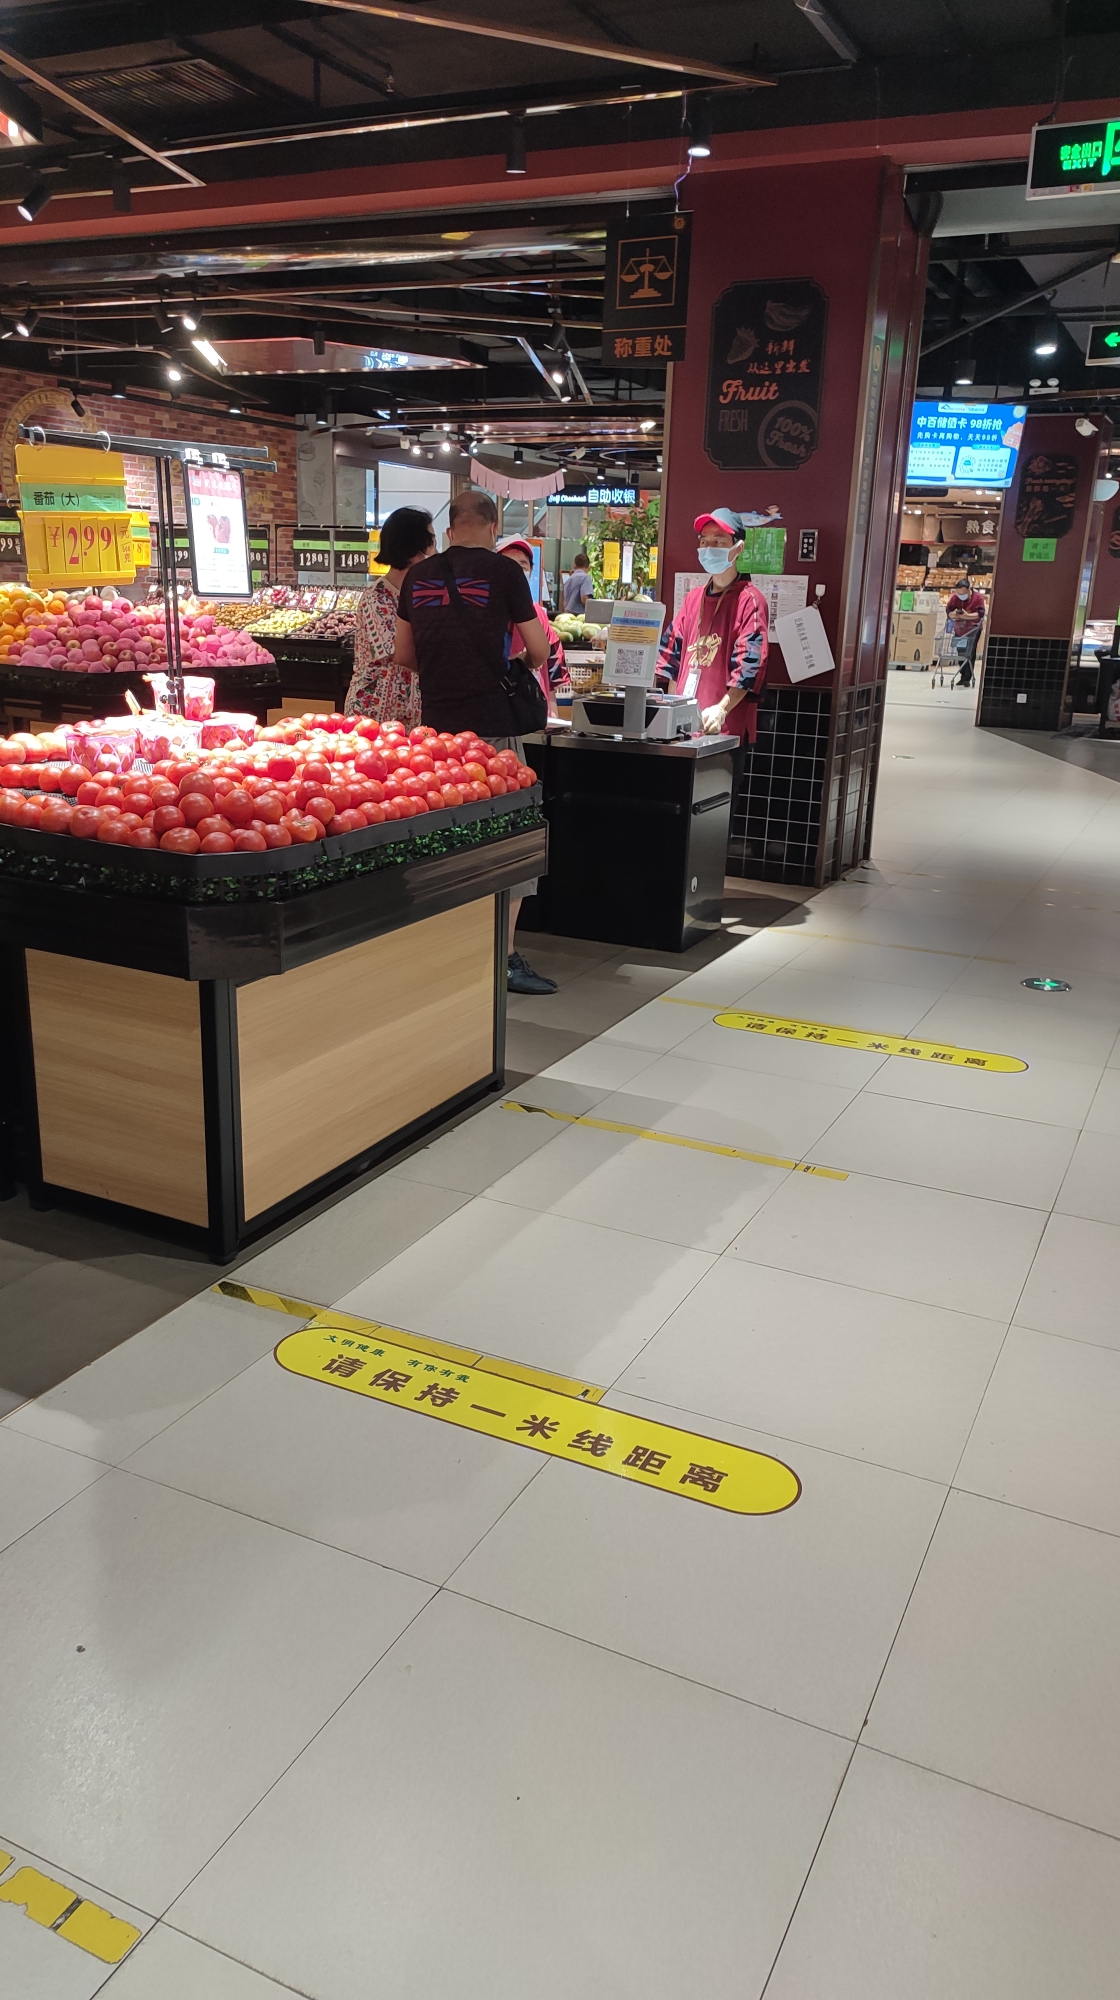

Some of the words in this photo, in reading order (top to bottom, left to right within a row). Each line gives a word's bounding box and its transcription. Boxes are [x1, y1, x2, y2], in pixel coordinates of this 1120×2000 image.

[1062, 157, 1098, 170] EXIT
[614, 335, 673, 358] 称重处
[719, 379, 779, 404] Fruit
[718, 409, 748, 433] FRESH
[774, 415, 815, 443] 100%
[916, 416, 968, 429] 中百储值卡
[969, 418, 1003, 431] 98折抢
[587, 487, 636, 504] 自助收银
[744, 1021, 988, 1068] 请保持一米线距离
[323, 1333, 387, 1358] 文明健康
[406, 1358, 472, 1384] 有你有我
[321, 1353, 729, 1494] 请保持一米线距离
